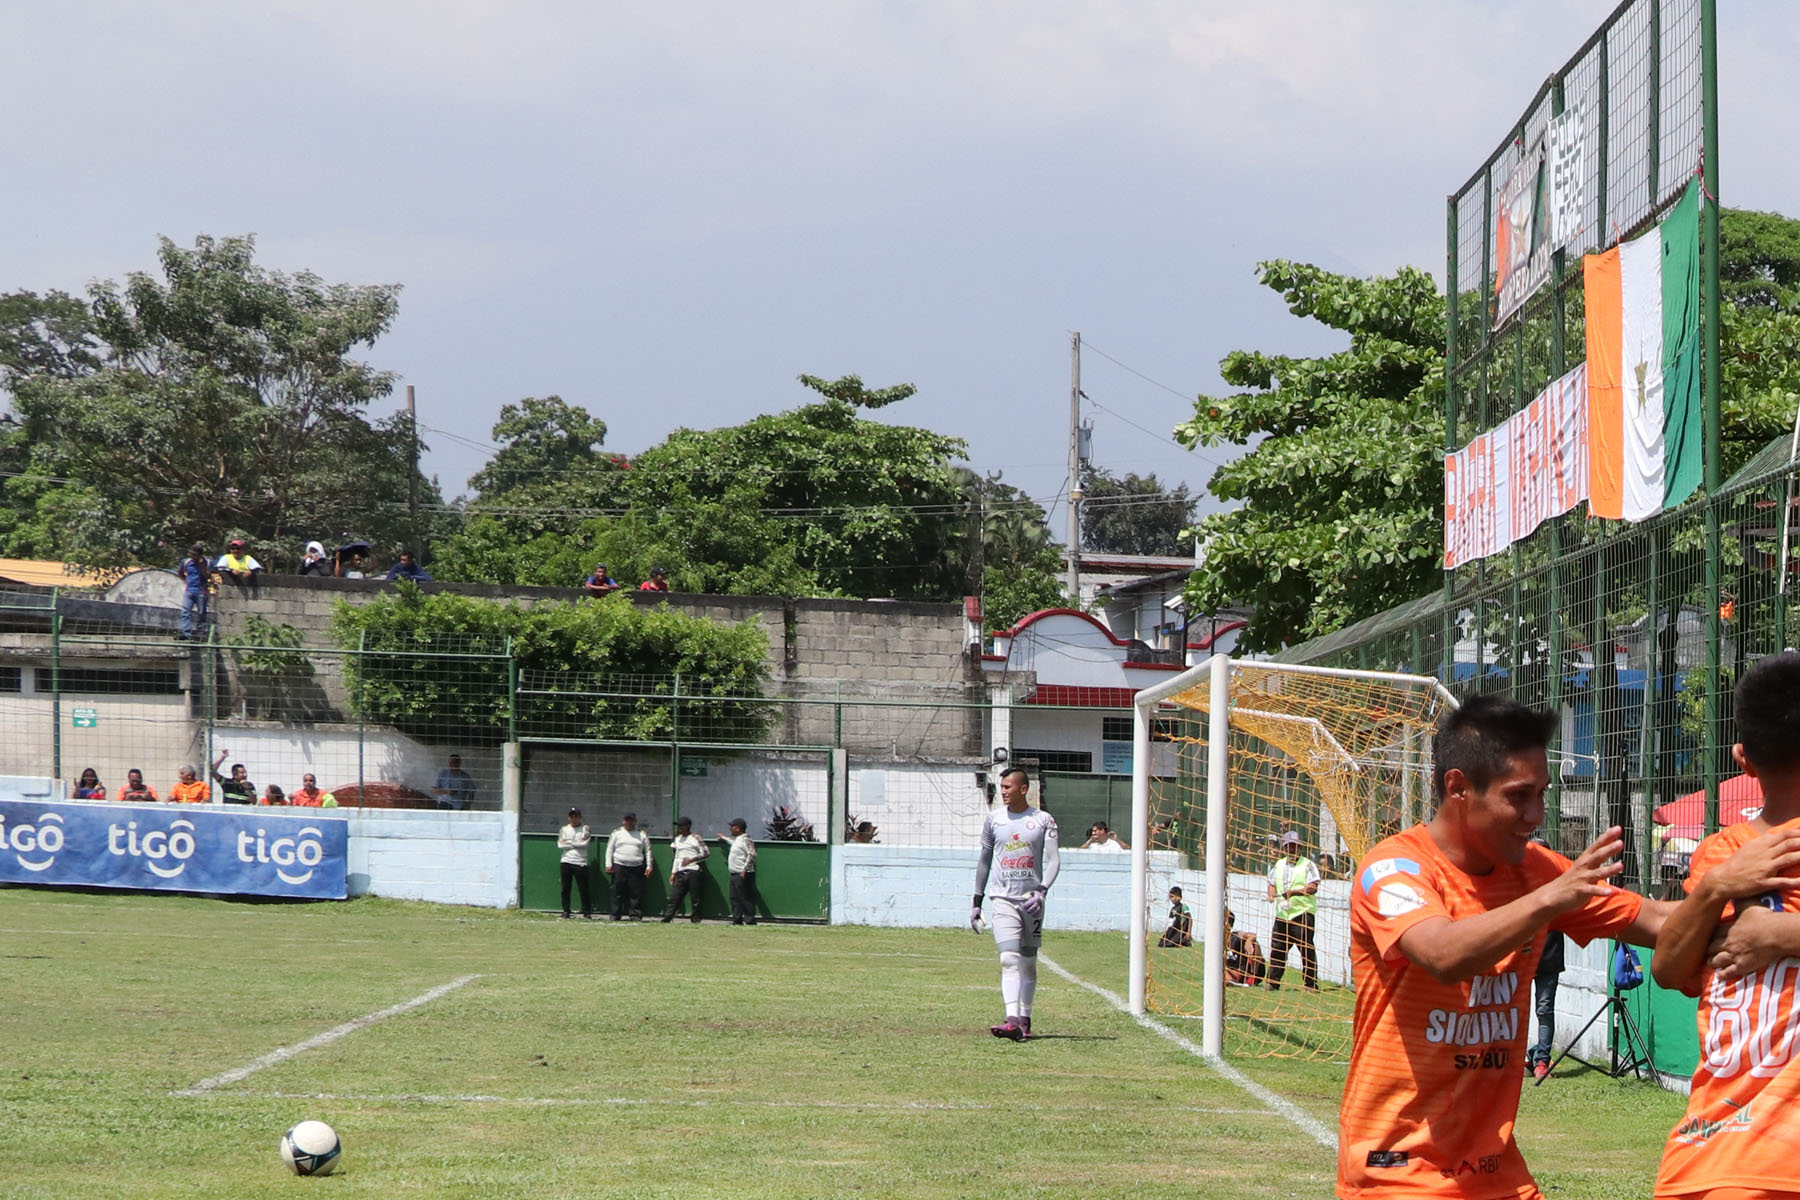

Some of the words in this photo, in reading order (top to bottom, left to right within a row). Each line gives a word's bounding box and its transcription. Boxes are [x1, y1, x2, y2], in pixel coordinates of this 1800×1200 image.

[0, 812, 65, 852] igo
[108, 819, 196, 860] tigo
[237, 826, 323, 867] tigo
